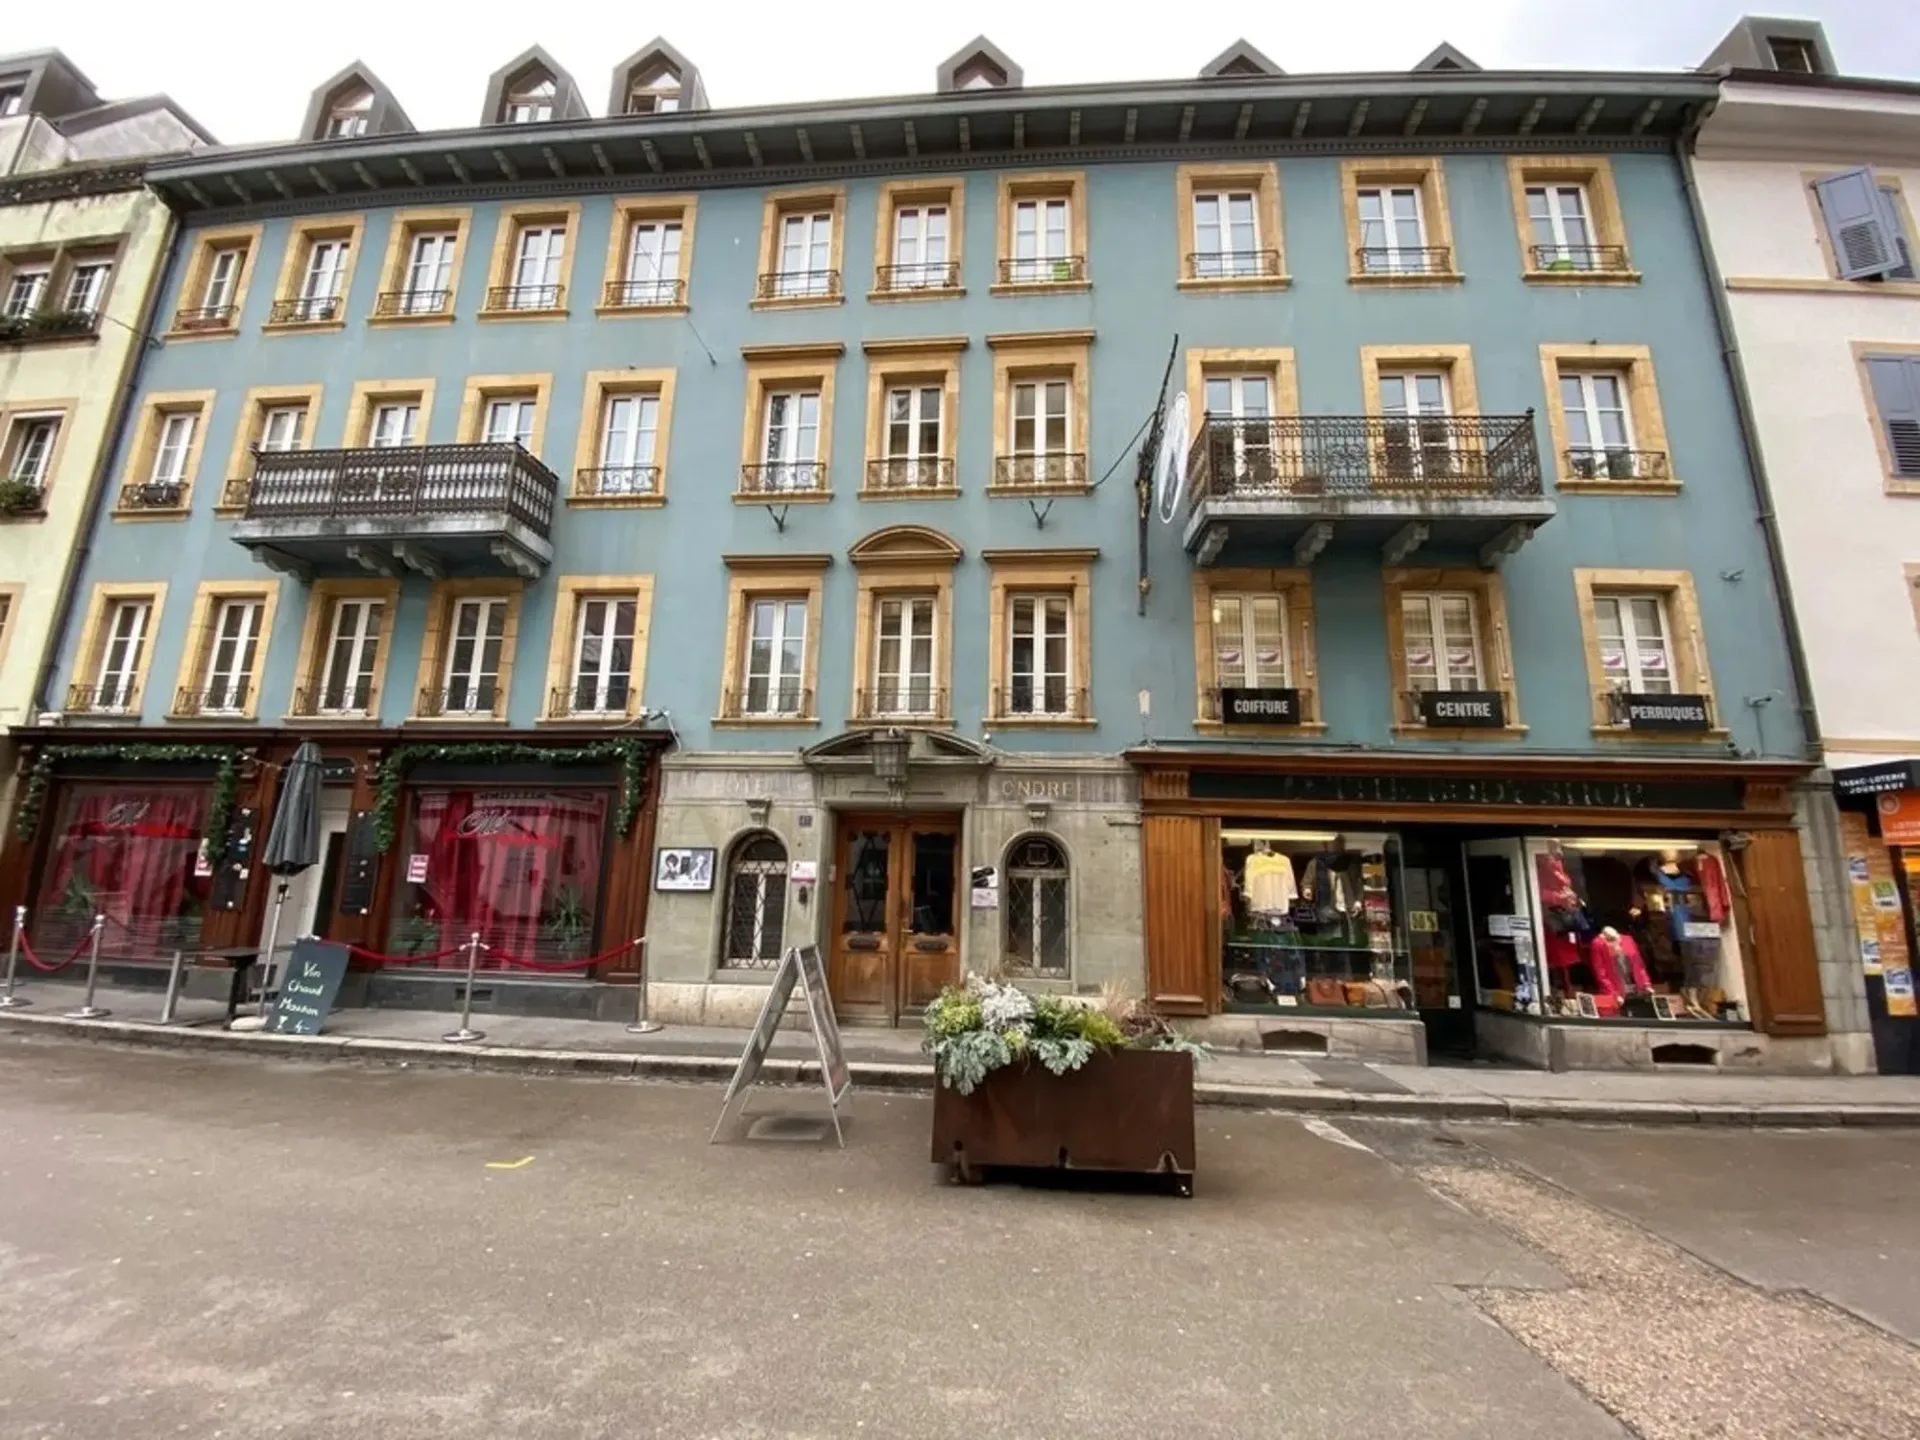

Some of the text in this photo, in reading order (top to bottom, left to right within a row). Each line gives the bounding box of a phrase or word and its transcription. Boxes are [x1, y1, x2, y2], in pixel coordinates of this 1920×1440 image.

[1233, 699, 1289, 714] COIFFURE
[1435, 701, 1492, 717] CENTRE
[1629, 705, 1704, 721] PERRUQUES
[303, 960, 321, 978] Vin
[288, 979, 324, 996] Chaud
